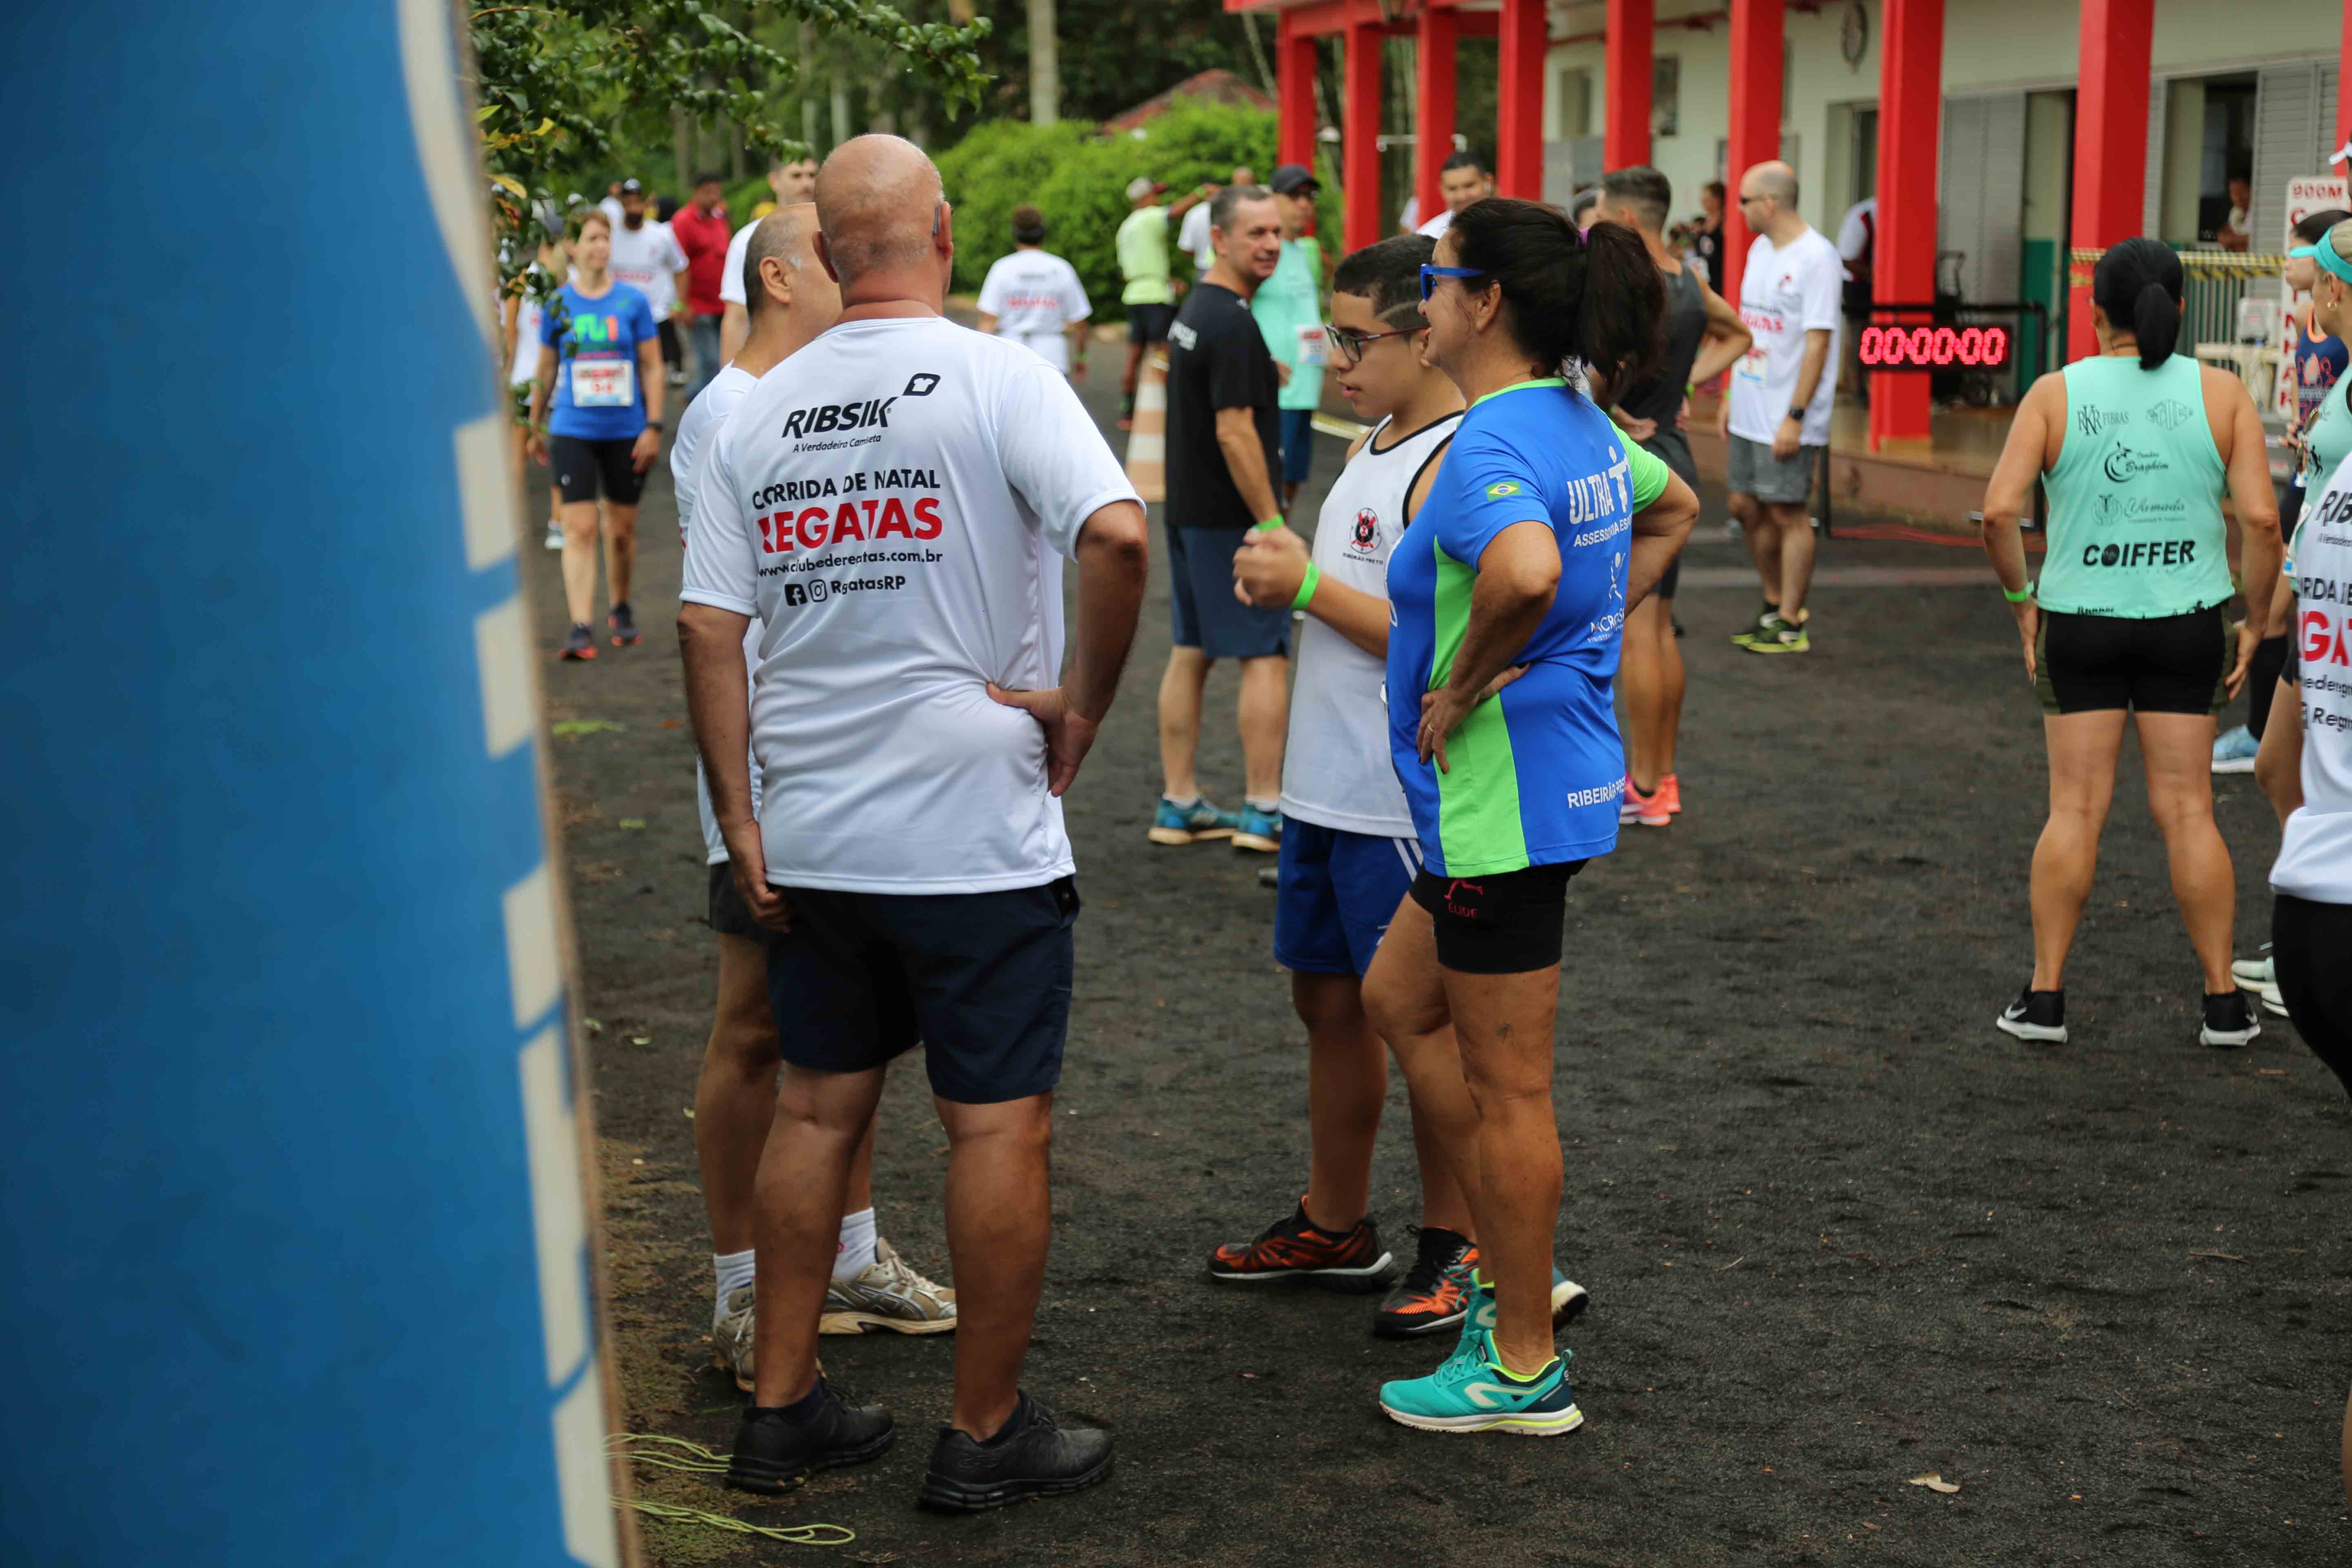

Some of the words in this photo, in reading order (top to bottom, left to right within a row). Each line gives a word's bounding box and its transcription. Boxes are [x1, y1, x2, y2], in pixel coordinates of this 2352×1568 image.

[1860, 327, 2006, 365] 00:00:00
[801, 439, 849, 452] Verdadeira
[752, 478, 838, 510] CORRIDA
[842, 472, 867, 493] DE
[874, 469, 941, 490] NATAL
[1566, 471, 1615, 525] ULTRA
[2083, 539, 2196, 567] COIFFER
[1567, 781, 1616, 809] RIBEIRÃO
